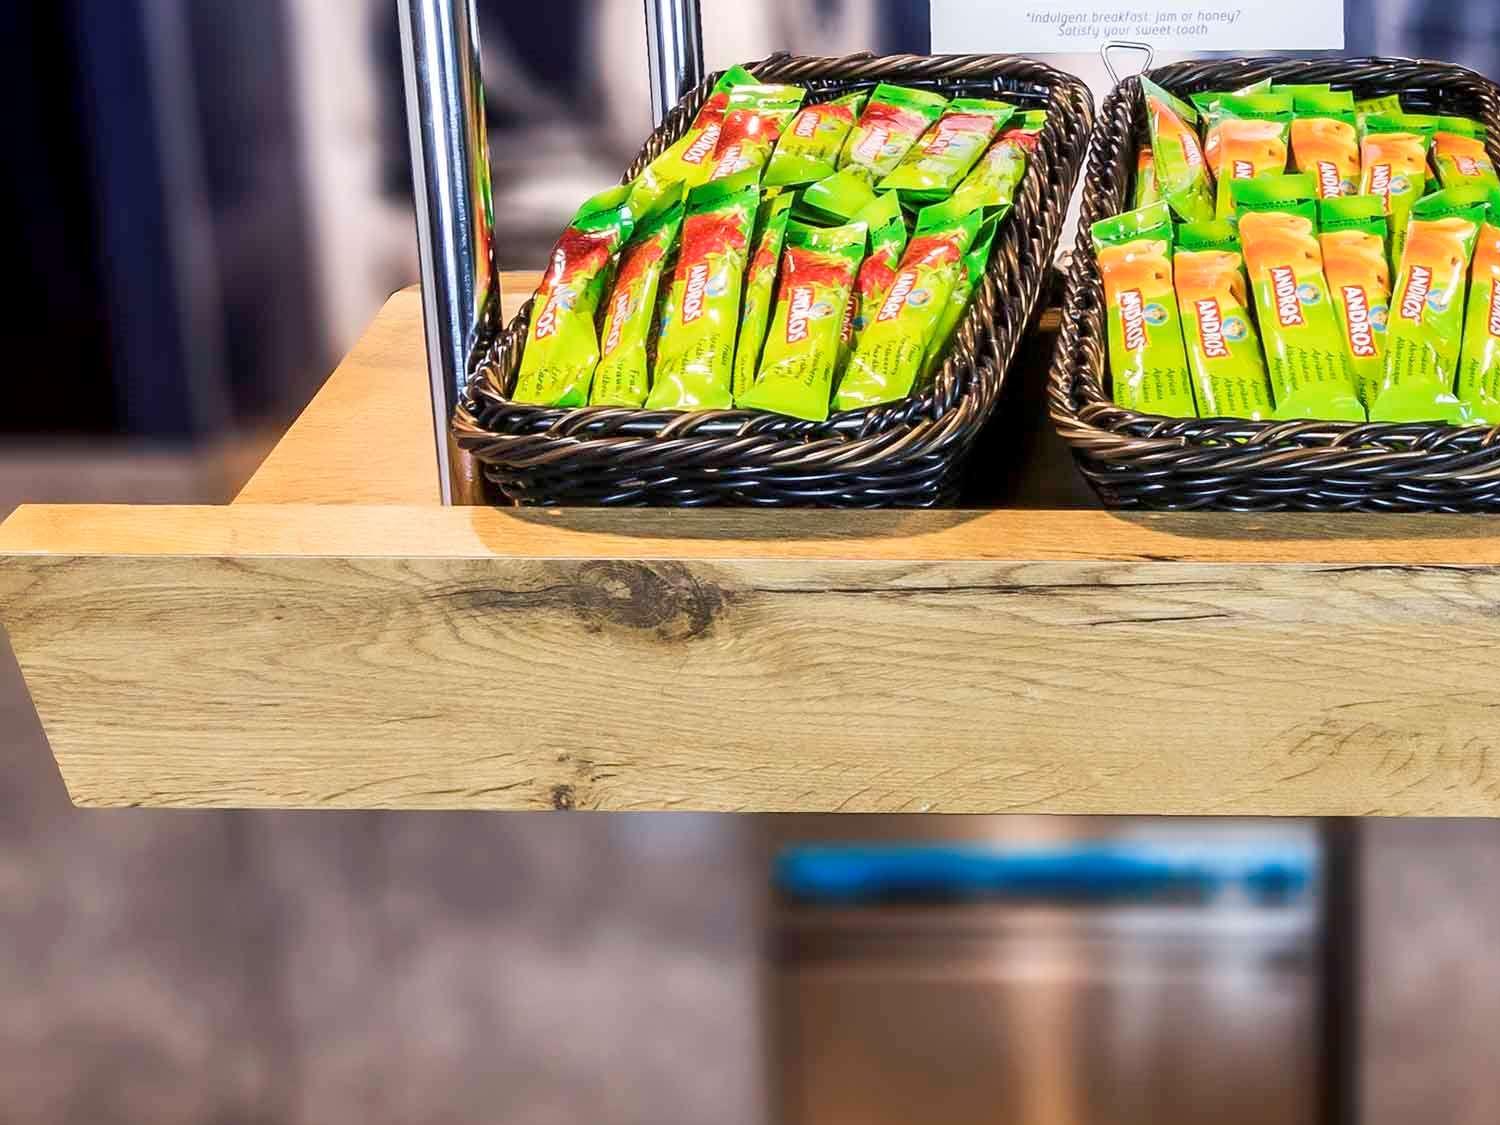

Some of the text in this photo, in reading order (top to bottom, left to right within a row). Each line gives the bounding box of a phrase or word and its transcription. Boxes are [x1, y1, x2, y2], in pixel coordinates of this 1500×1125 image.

[1057, 24, 1100, 39] Satisfy
[1103, 26, 1131, 39] your
[1196, 10, 1241, 25] honey?
[1272, 267, 1301, 325] ANDROS
[1343, 286, 1374, 356] ANDROS
[1402, 266, 1430, 321] ANDROS
